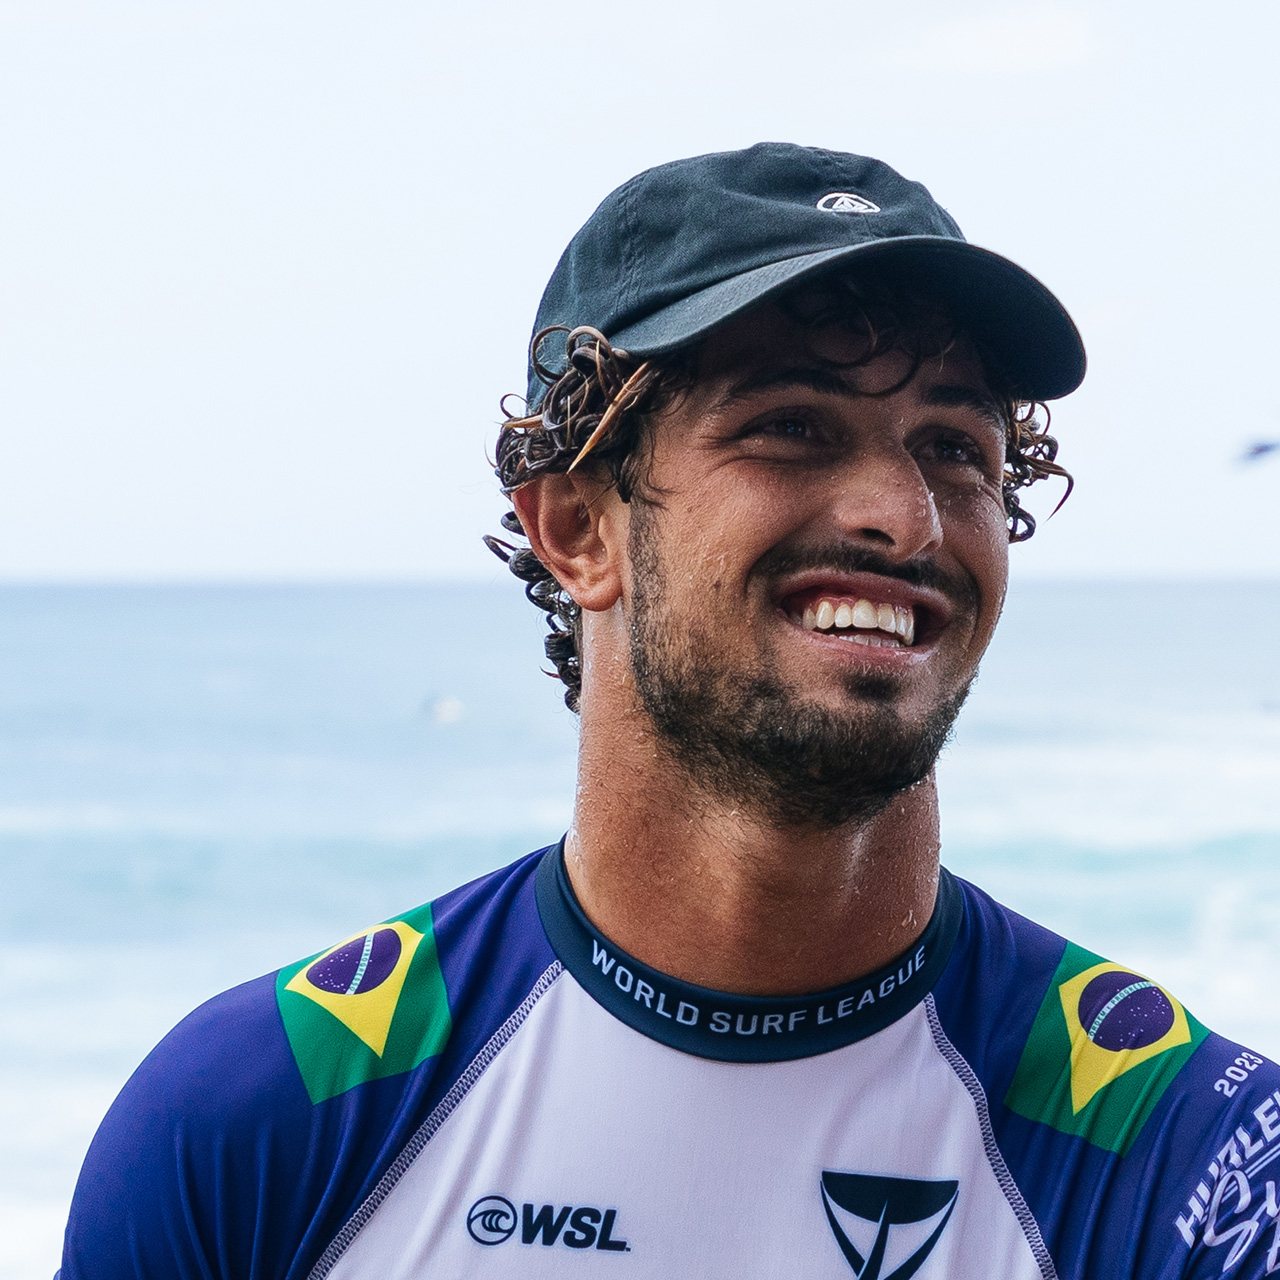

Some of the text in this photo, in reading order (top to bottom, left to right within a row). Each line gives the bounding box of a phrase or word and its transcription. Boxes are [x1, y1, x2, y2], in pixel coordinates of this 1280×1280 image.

[591, 939, 926, 1036] WORLD SURF LEAGUE
[1213, 1051, 1264, 1098] 2023
[521, 1203, 628, 1251] WSL
